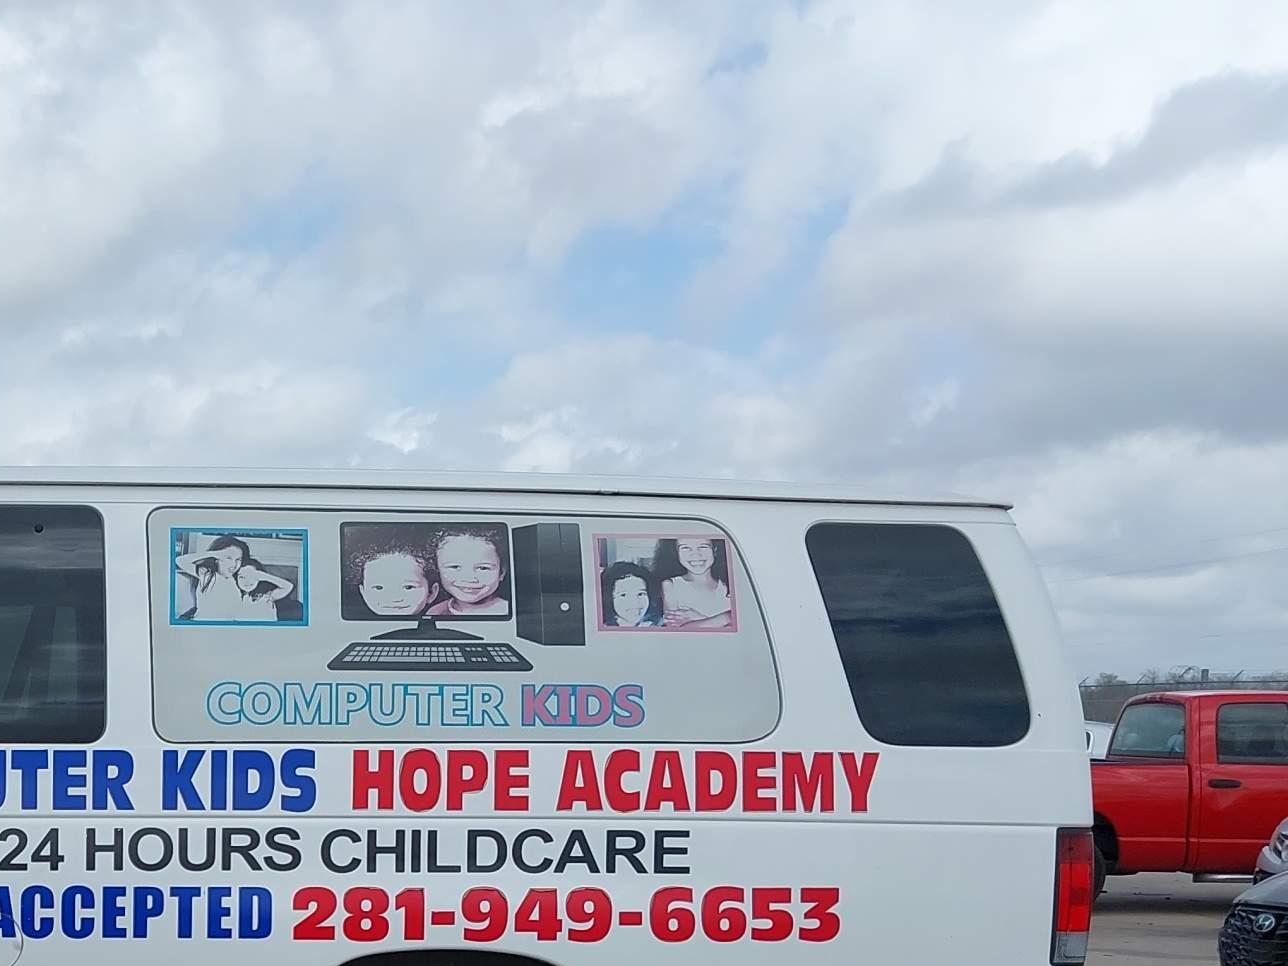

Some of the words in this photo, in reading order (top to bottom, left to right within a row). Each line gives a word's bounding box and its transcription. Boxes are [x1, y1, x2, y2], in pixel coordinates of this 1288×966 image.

[207, 682, 510, 726] COMPUTER
[520, 684, 646, 728] KIDS
[162, 748, 317, 812] KIDS
[352, 749, 530, 812] HOPE
[556, 749, 879, 813] ACADEMY
[85, 827, 302, 872] HOURS
[320, 829, 691, 874] CHILDCARE
[292, 886, 841, 942] 281-949-6653
